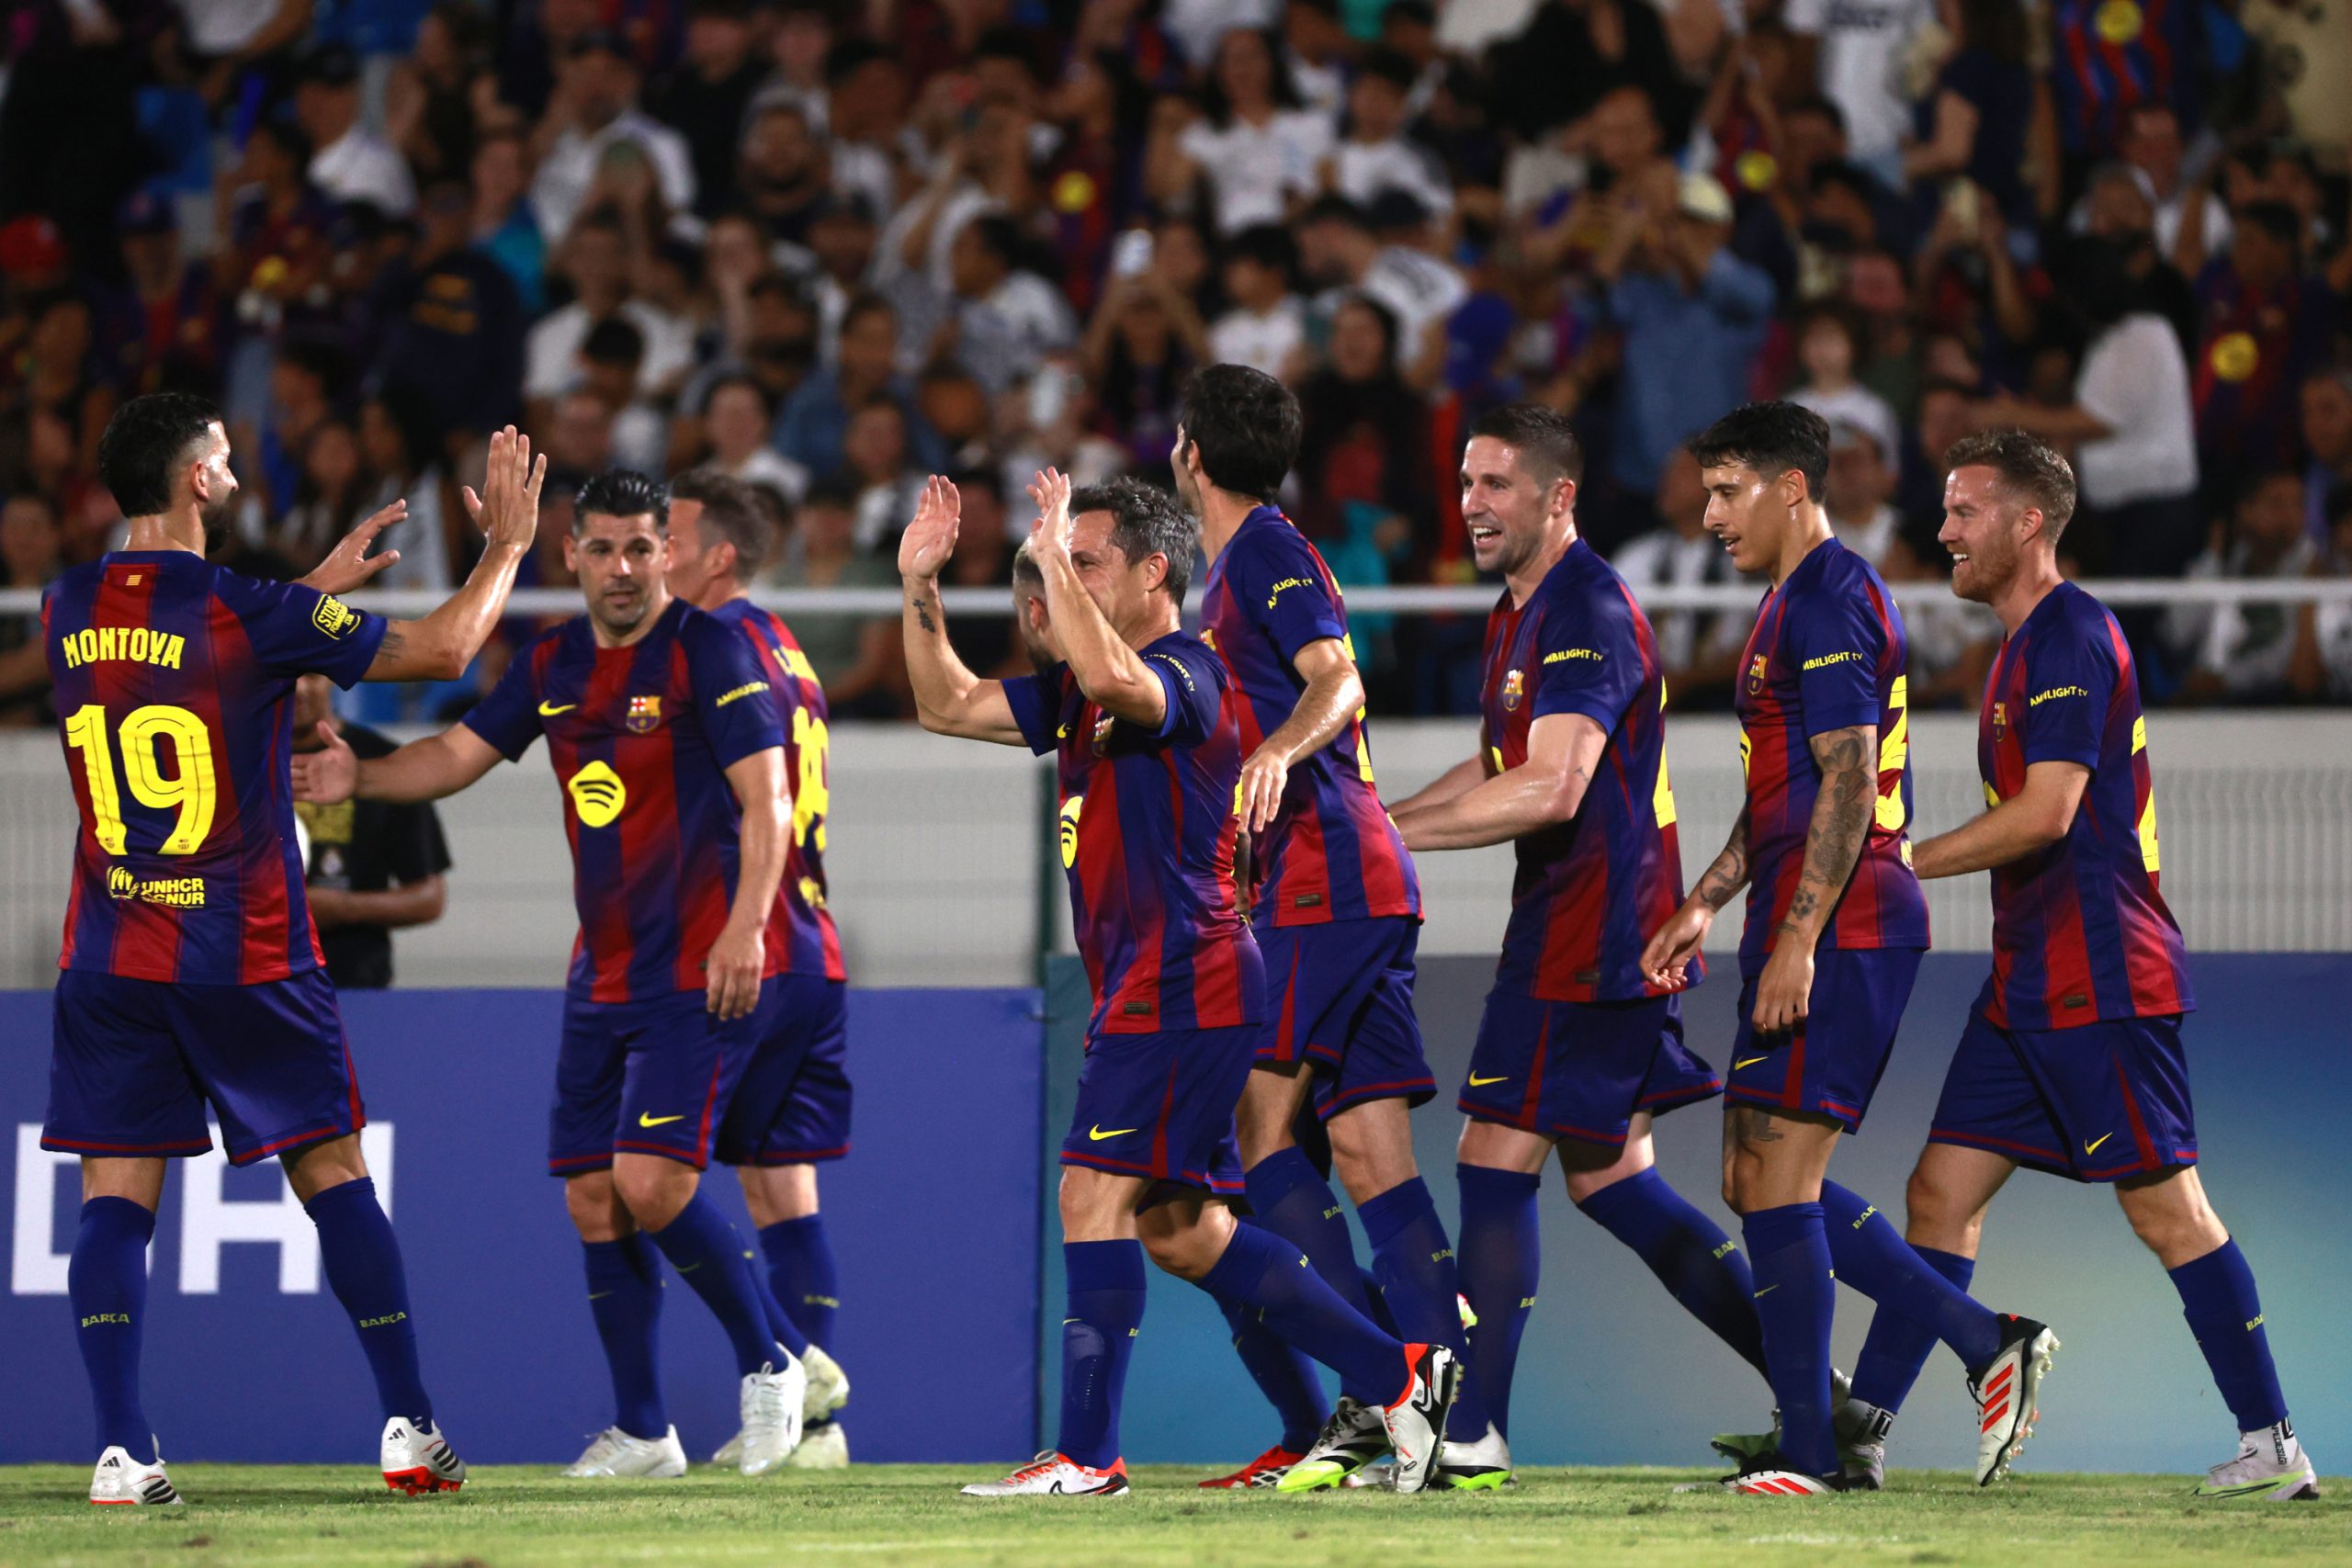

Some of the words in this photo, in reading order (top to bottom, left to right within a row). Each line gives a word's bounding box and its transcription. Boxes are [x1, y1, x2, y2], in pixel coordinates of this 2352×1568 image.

[62, 627, 186, 670] MONTOYA
[1592, 651, 1602, 661] tv
[1851, 651, 1863, 661] tv
[2078, 687, 2088, 697] tv
[65, 705, 216, 855] 19
[141, 877, 205, 897] UNHCR
